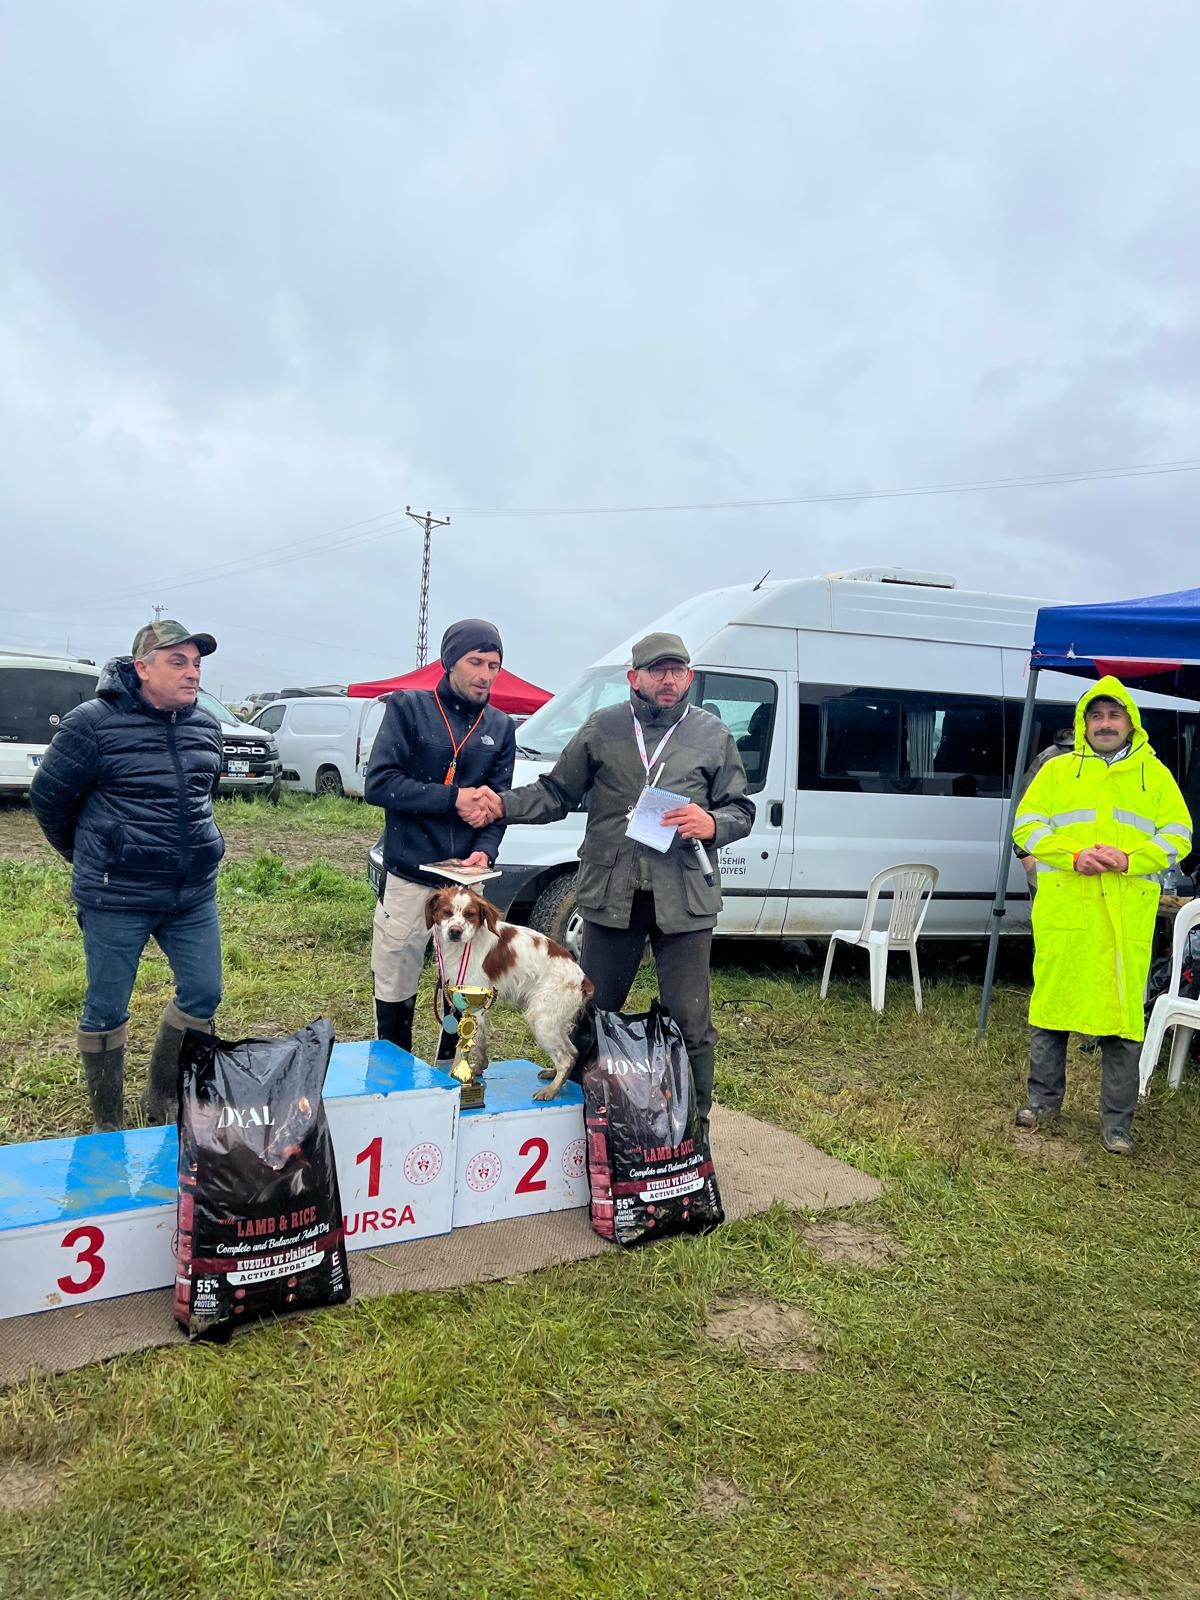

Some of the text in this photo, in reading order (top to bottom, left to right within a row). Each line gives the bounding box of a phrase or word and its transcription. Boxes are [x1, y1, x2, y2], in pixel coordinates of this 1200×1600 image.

[222, 746, 266, 754] ORD
[643, 1146, 672, 1163] LAMB
[356, 1137, 383, 1198] 1
[515, 1137, 549, 1195] 2
[629, 1167, 656, 1179] Complete
[656, 1165, 667, 1174] and
[672, 1177, 680, 1186] VE
[649, 1184, 694, 1200] ACTIVE SPORT
[616, 1198, 635, 1210] 55%
[237, 1217, 276, 1238] LAMB
[279, 1215, 288, 1232] &
[291, 1206, 317, 1229] RICE
[343, 1204, 416, 1236] URSA
[216, 1222, 330, 1256] Complete and Balanced Adult Dog
[56, 1225, 106, 1295] 3
[237, 1257, 272, 1271] KUZULU
[273, 1254, 285, 1265] VE
[239, 1269, 276, 1282] ACTIVE
[278, 1261, 307, 1274] SPORT
[196, 1279, 219, 1293] 55%
[197, 1293, 217, 1301] ANIMAL
